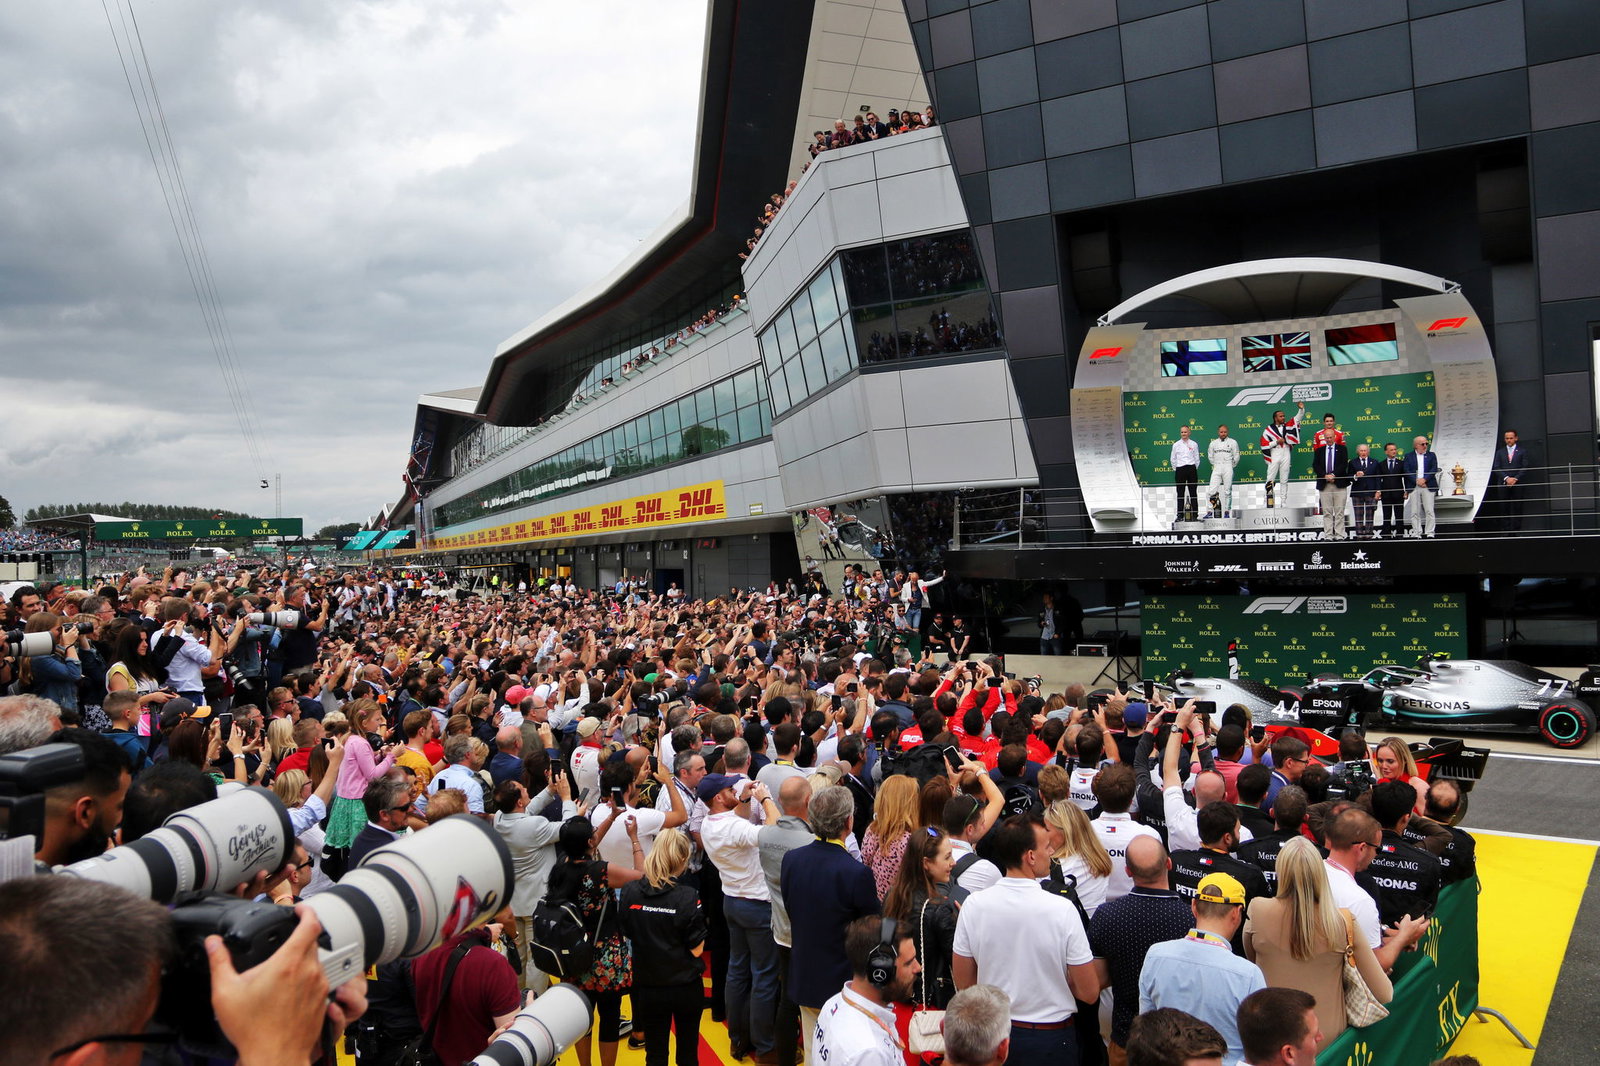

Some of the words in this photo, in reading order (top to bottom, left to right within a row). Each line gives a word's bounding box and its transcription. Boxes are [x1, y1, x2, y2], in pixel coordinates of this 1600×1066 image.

[572, 511, 595, 531] DHL
[600, 505, 628, 527] DHL
[633, 498, 669, 523] DHL
[675, 488, 722, 519] DHL
[1254, 518, 1290, 526] CARBON
[1132, 535, 1189, 545] FORMULA
[1189, 535, 1200, 544] 1
[1201, 534, 1244, 544] ROLEX
[1245, 532, 1298, 542] BRITISH
[1257, 562, 1294, 571] PIRELLI
[1340, 561, 1381, 569] Heineken
[1537, 678, 1568, 697] 77
[1312, 699, 1341, 708] EPSON
[1401, 698, 1471, 710] PETRONAS
[1271, 700, 1300, 720] 44
[1069, 793, 1097, 801] TRONA
[1372, 857, 1419, 871] cedes-AMG
[1373, 876, 1417, 890] TRONAS
[642, 905, 676, 914] Experiences
